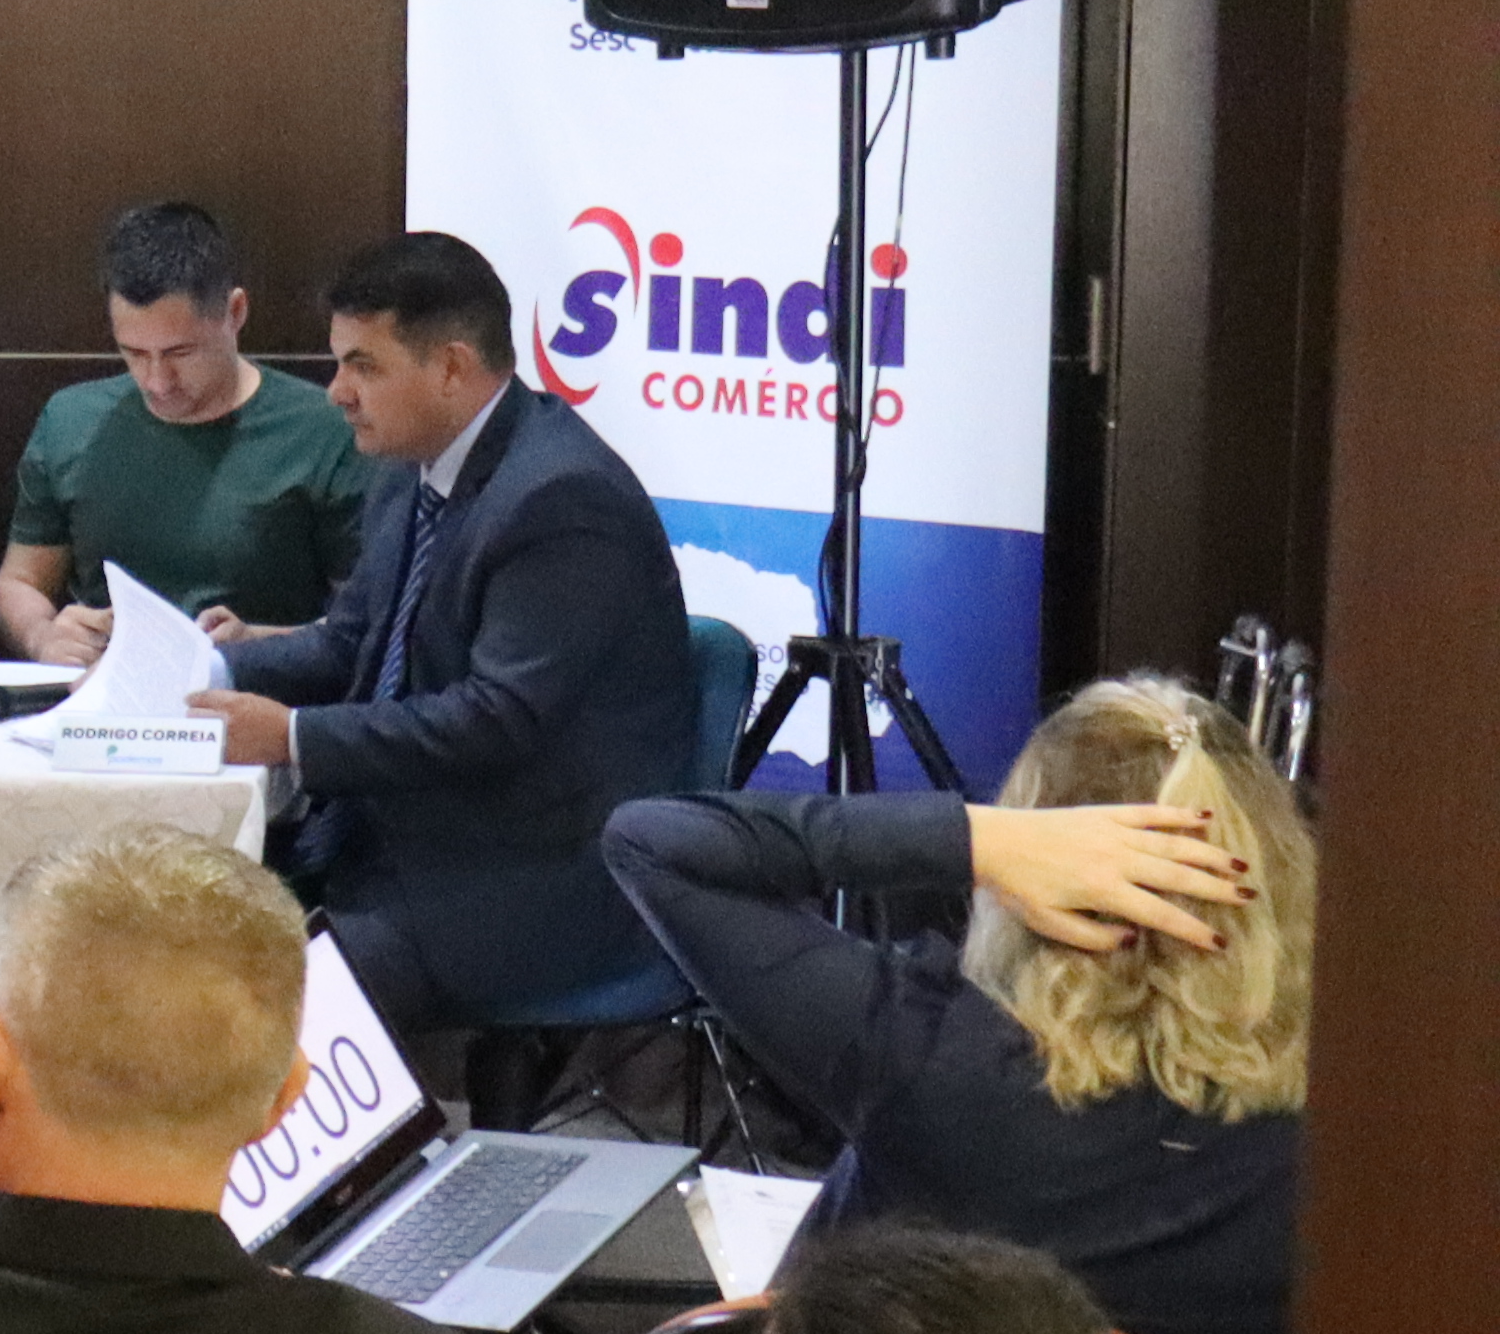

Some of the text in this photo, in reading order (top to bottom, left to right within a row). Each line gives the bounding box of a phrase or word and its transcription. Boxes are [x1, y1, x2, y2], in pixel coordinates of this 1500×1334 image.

[642, 368, 904, 427] COMÉRCO
[62, 728, 217, 742] RODRIGO CORREIA
